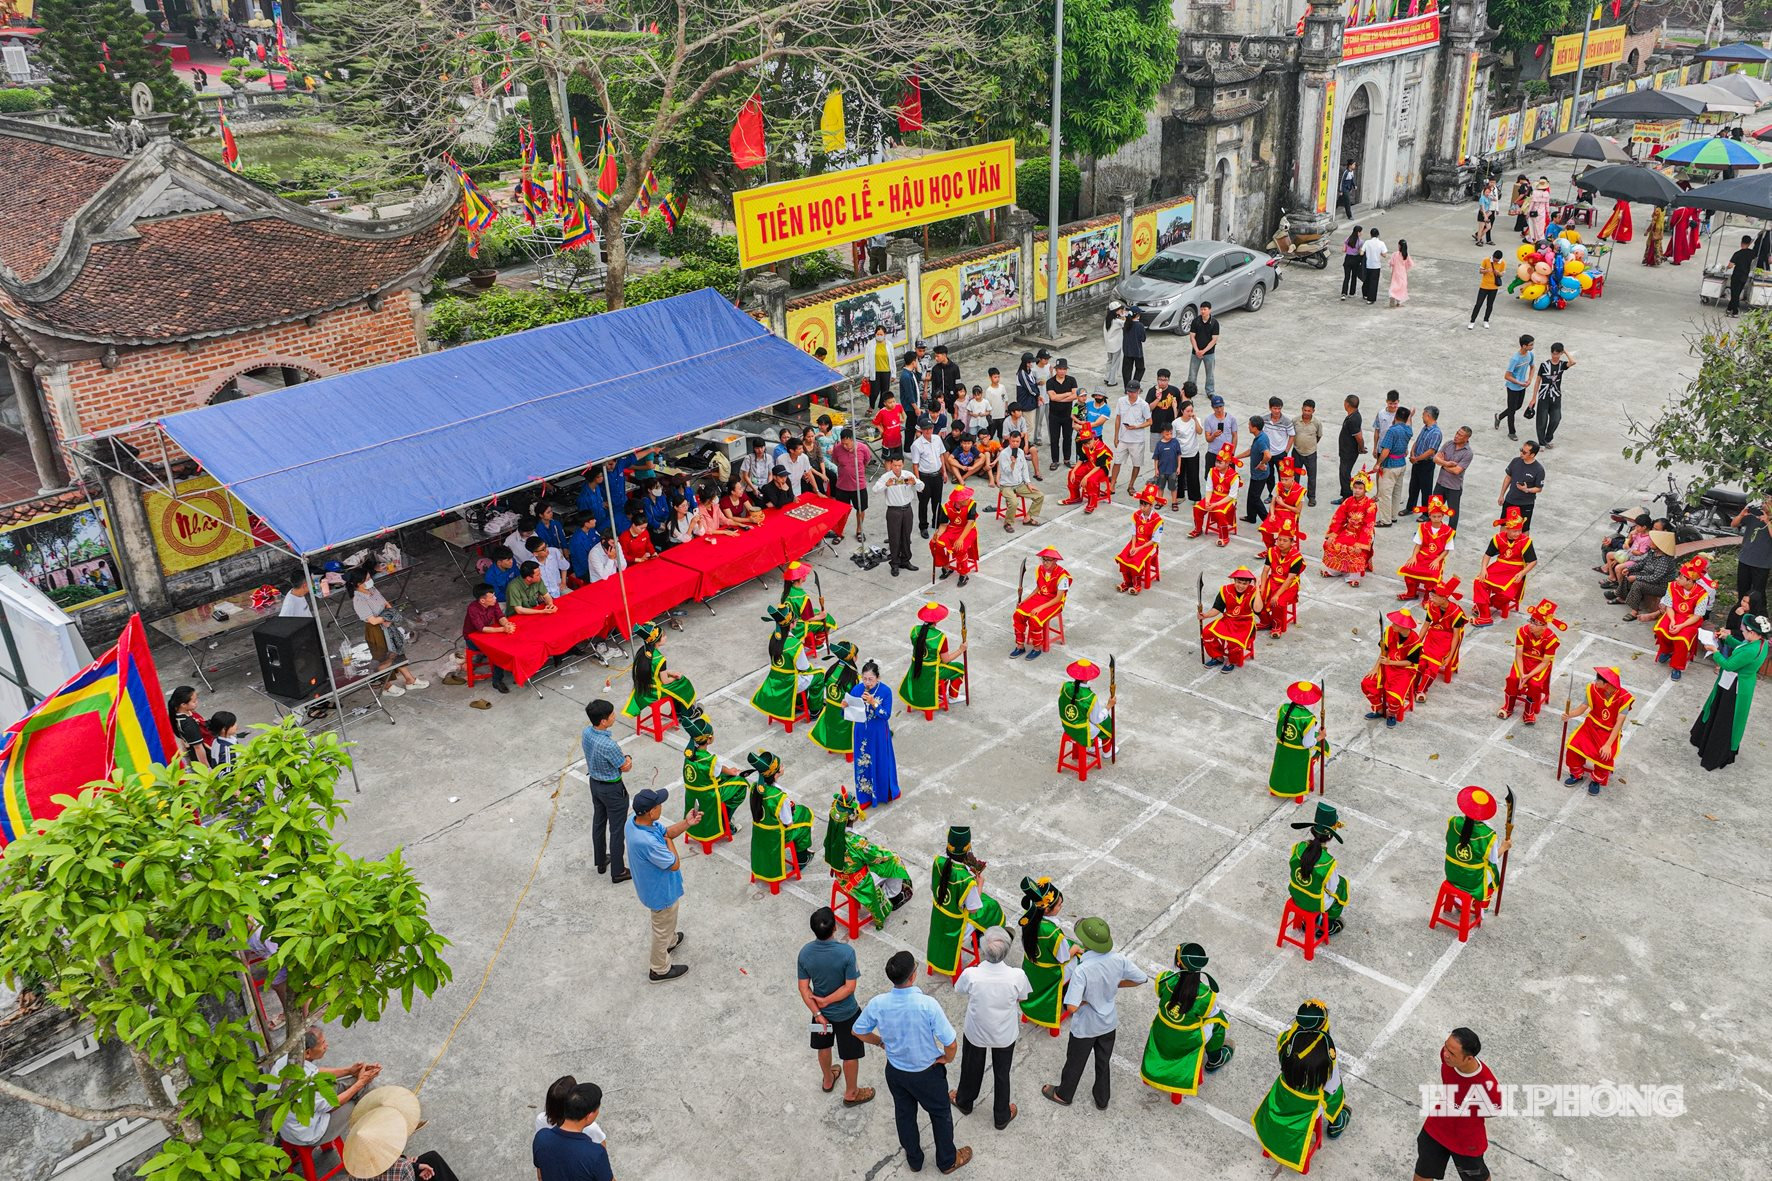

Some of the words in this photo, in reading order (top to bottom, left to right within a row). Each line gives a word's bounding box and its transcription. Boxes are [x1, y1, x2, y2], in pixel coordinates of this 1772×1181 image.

[757, 202, 804, 244] TIÊN
[808, 195, 847, 235] HỌC
[851, 179, 873, 222] LỄ
[889, 175, 925, 216] HẬU
[929, 171, 963, 208] HỌC
[967, 160, 1000, 196] VĂN
